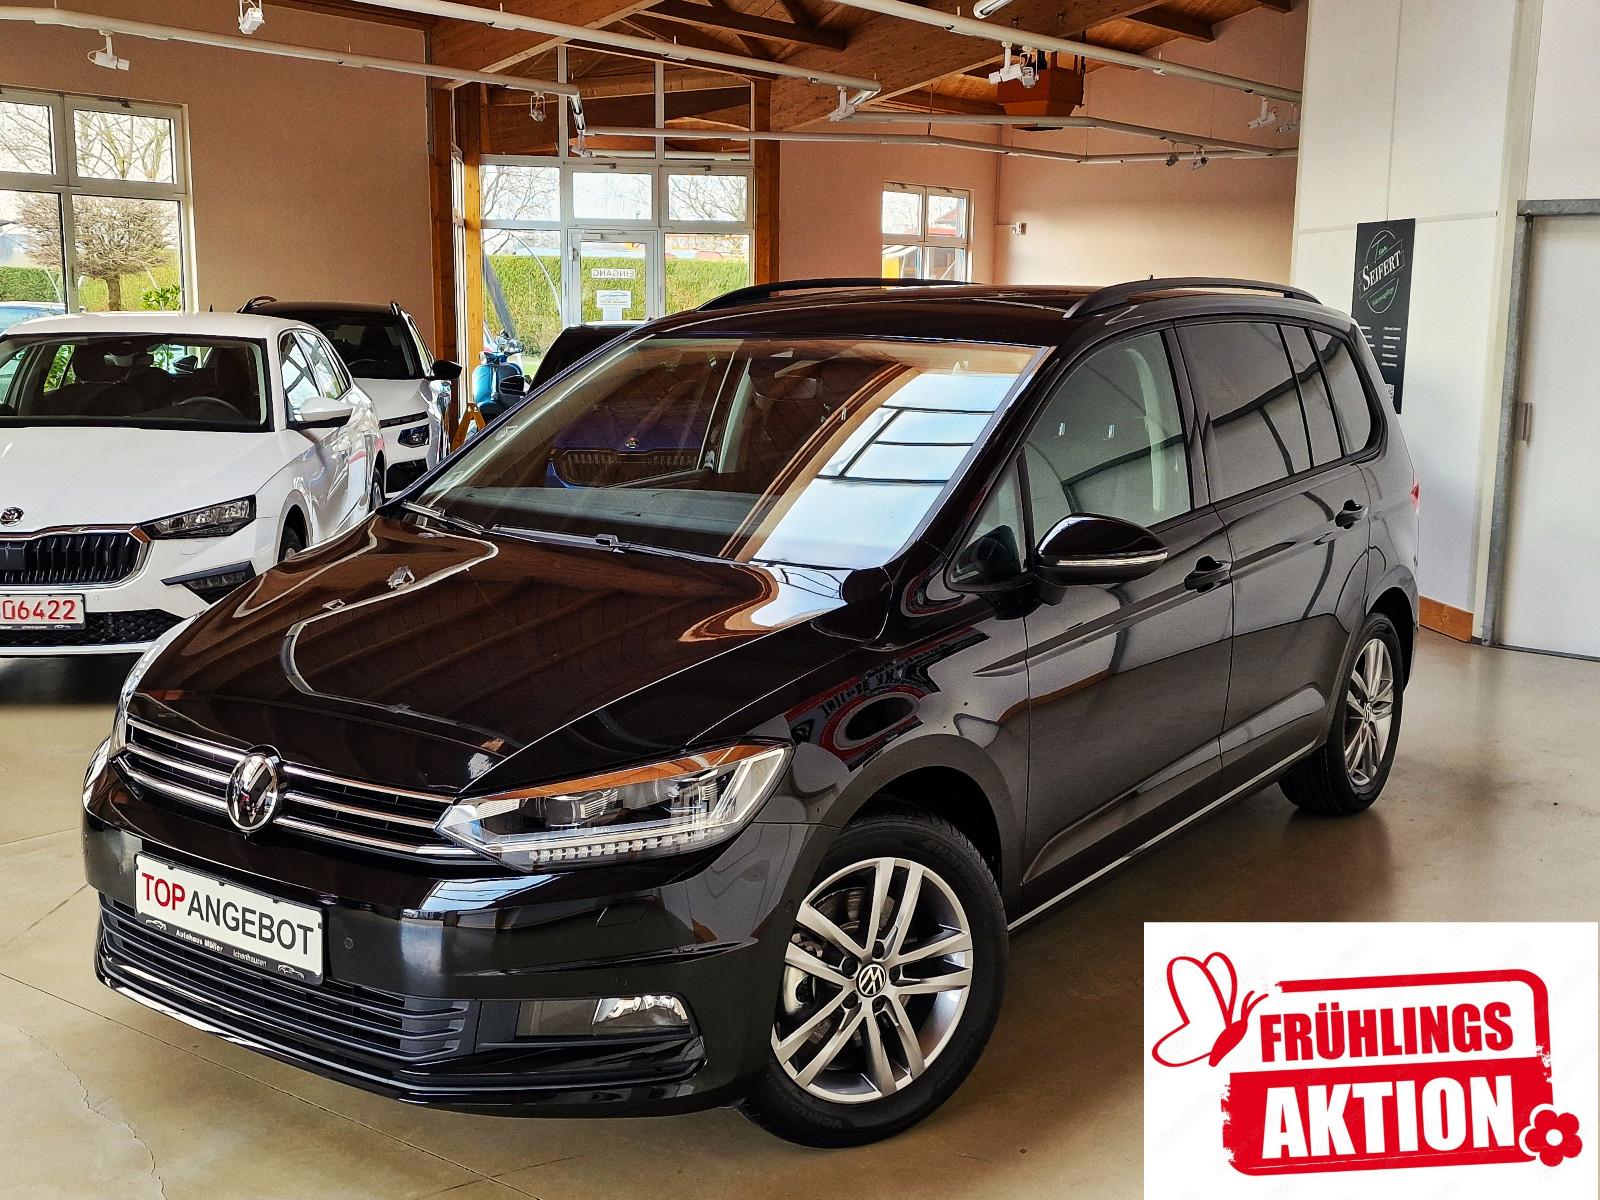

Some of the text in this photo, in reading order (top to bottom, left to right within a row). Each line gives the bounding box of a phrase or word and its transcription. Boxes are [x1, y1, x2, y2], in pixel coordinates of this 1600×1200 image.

[1362, 250, 1401, 291] SEIFERT
[142, 872, 314, 955] TOP ANGEBOT
[176, 929, 203, 945] Autohaus
[204, 938, 224, 953] Müller
